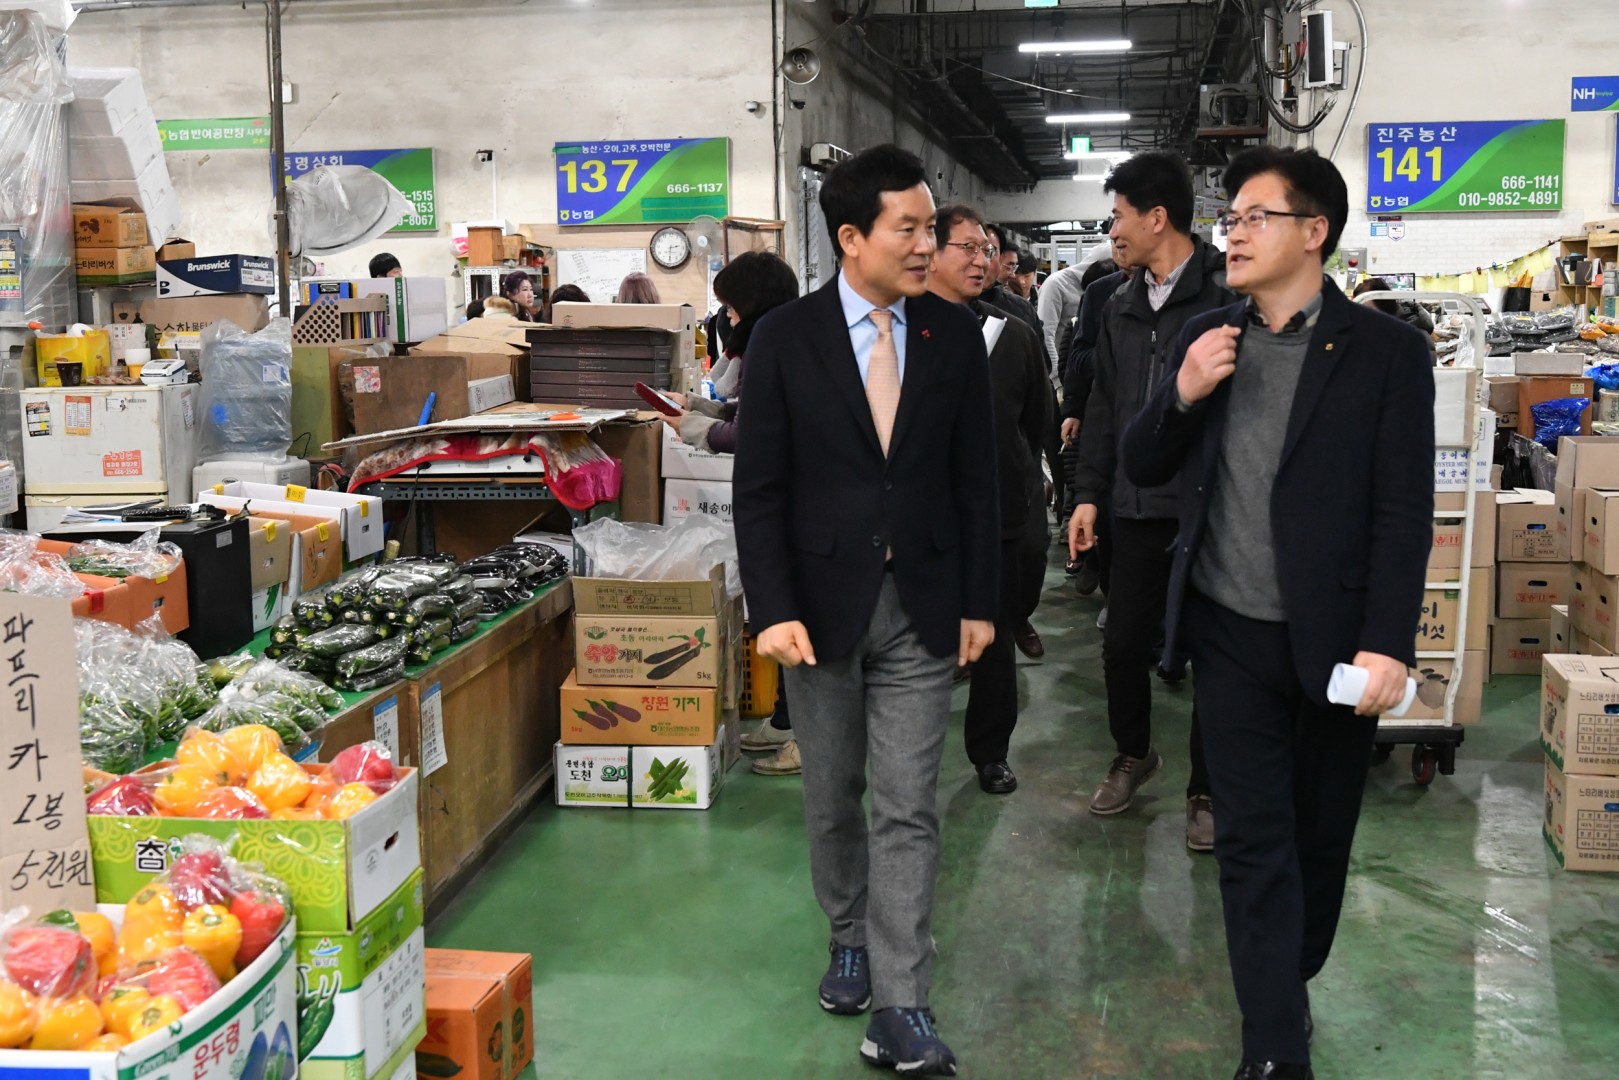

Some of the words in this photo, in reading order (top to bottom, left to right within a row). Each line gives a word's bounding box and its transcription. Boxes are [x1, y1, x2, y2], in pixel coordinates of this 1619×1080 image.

[1572, 87, 1596, 100] NH
[168, 129, 190, 140] 농협
[191, 128, 245, 140] 반여공판장
[1377, 127, 1457, 143] 진주농산
[1376, 146, 1442, 182] 141
[559, 159, 639, 194] 137
[1501, 175, 1559, 190] 666-1141
[666, 183, 724, 194] 666-1137
[1383, 196, 1409, 207] 농협
[1458, 191, 1559, 206] 010-9852-4891
[413, 203, 434, 213] 153
[571, 209, 595, 220] 농협
[187, 260, 232, 272] Brunswick
[243, 260, 269, 269] Brunswick
[697, 501, 733, 515] 새송이
[696, 671, 712, 680] 5kg
[641, 696, 669, 712] 창원
[672, 696, 700, 712] 가지
[569, 770, 592, 782] 도천
[11, 849, 93, 892] 5천원
